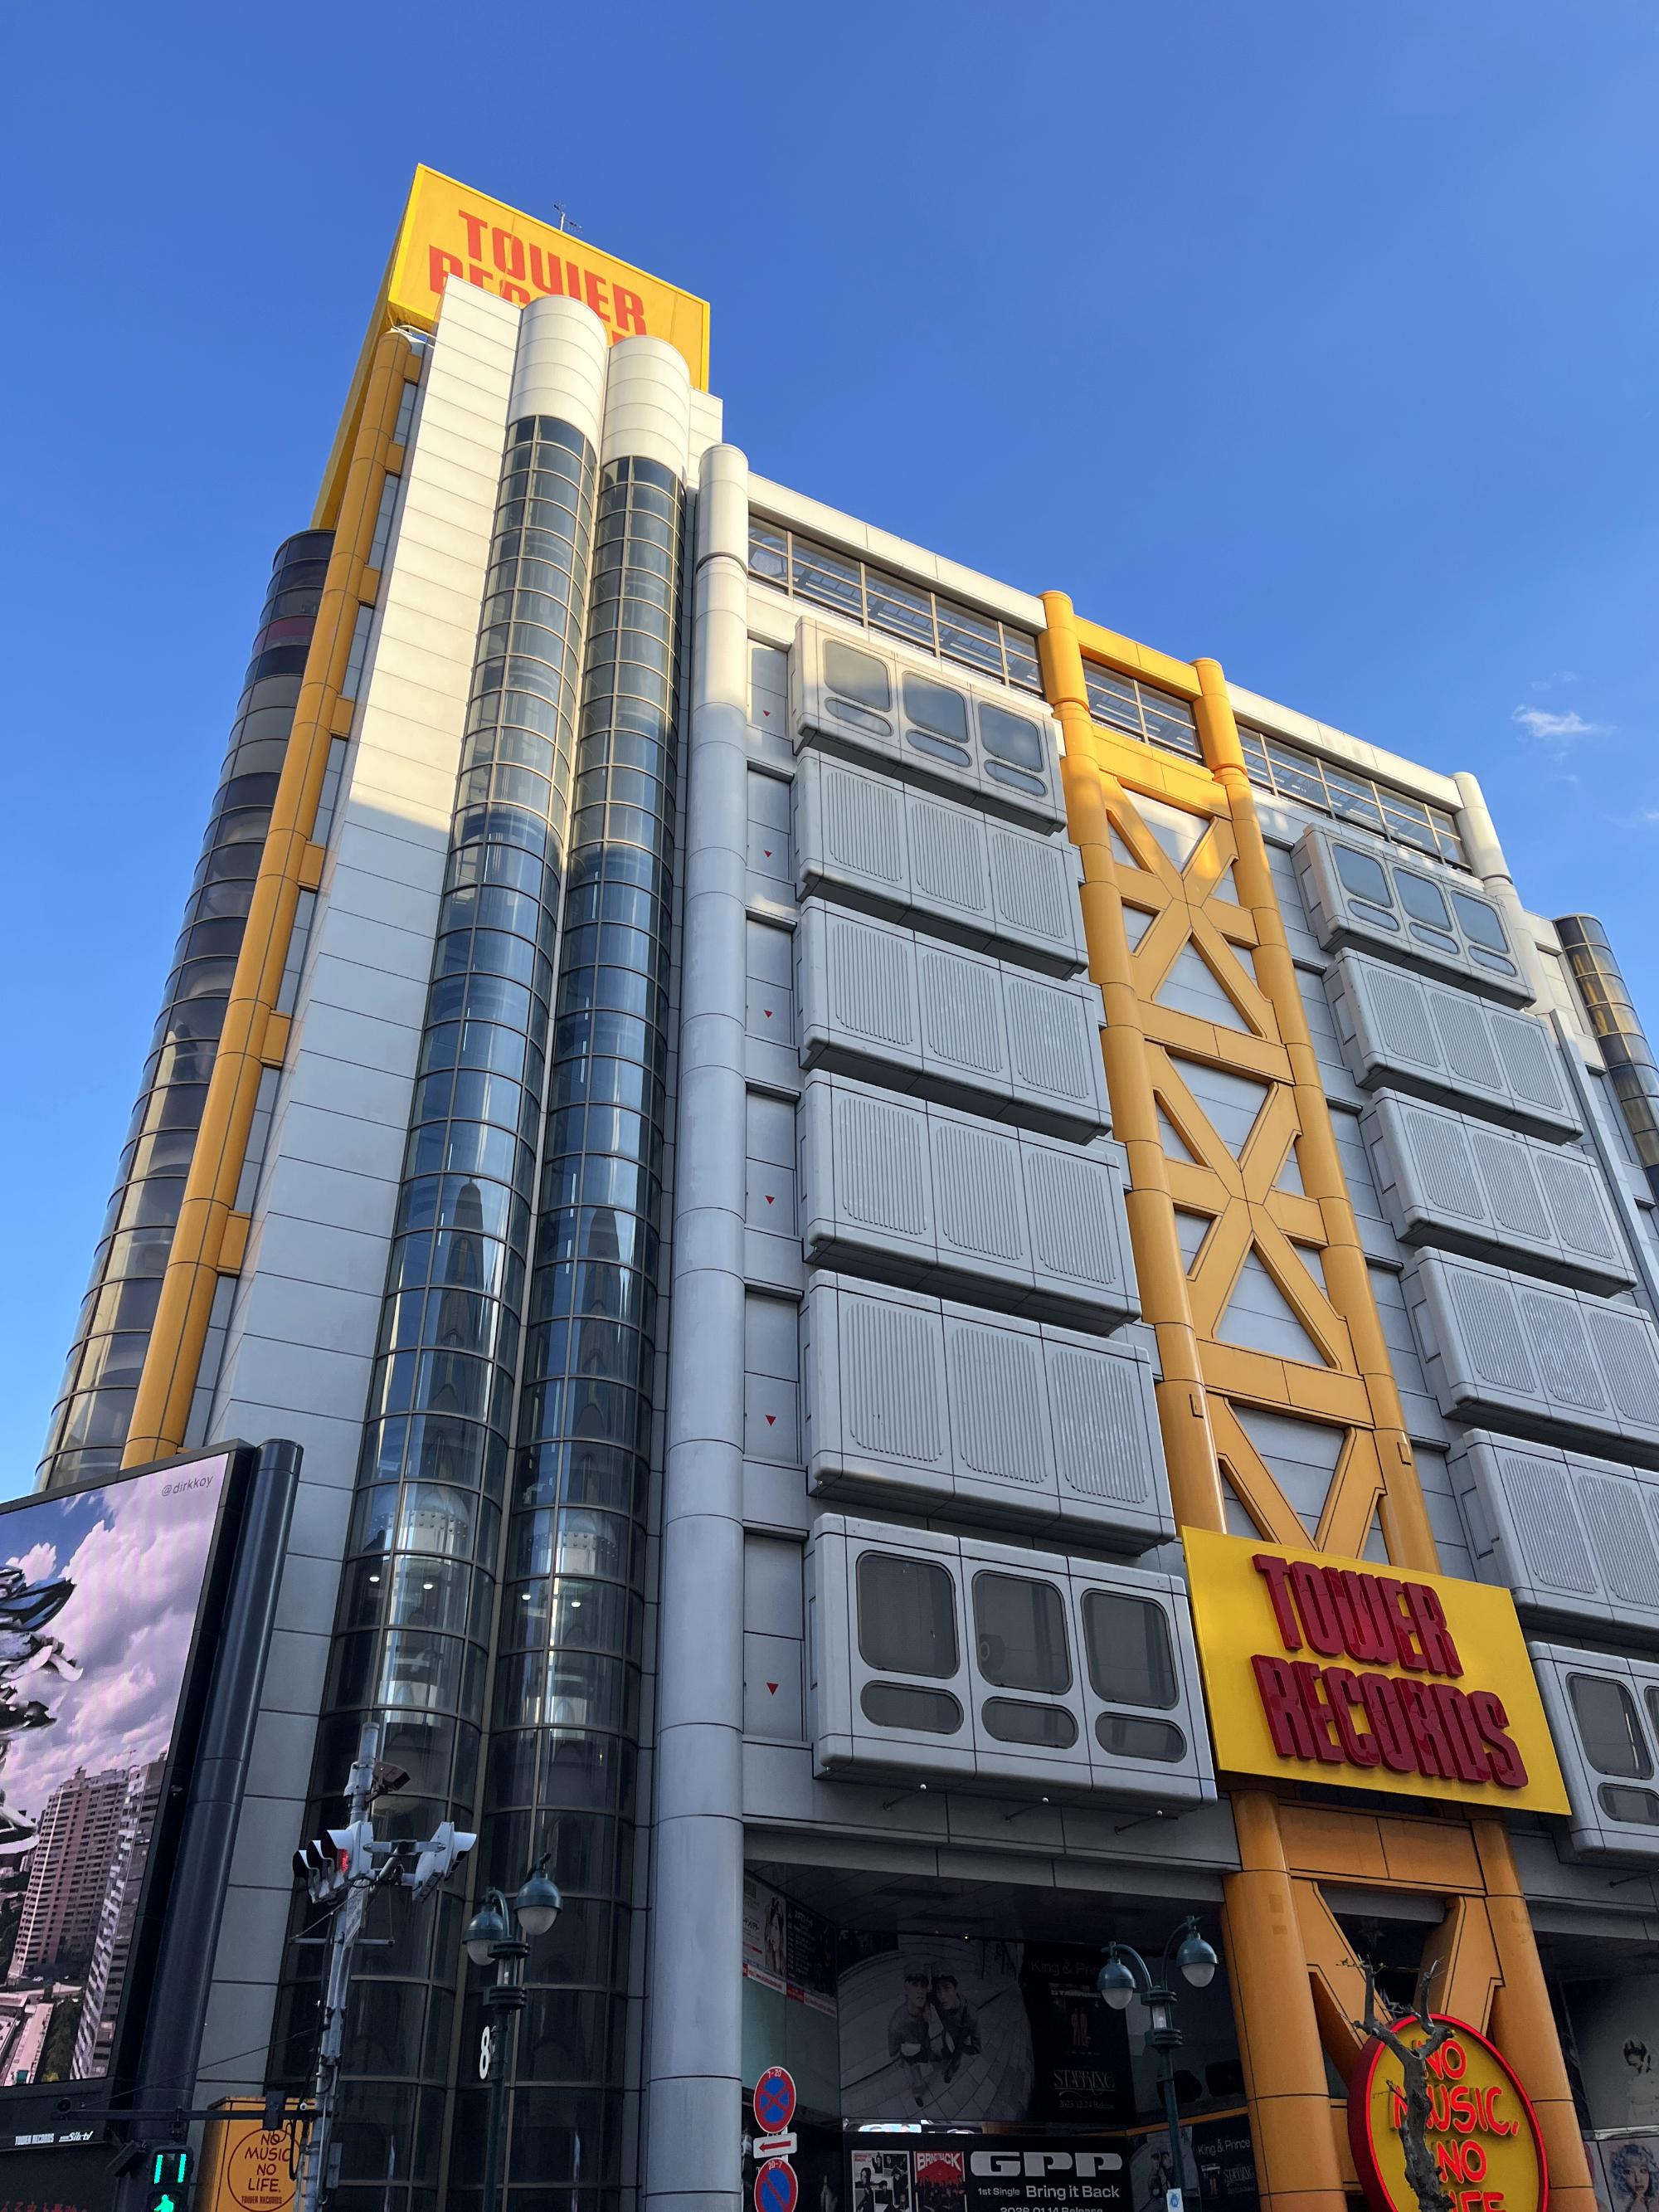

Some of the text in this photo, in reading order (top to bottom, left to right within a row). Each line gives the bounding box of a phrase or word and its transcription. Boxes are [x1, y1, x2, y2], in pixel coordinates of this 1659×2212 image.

[459, 209, 646, 335] TOWER
[161, 1476, 213, 1497] @dirkkoy
[1252, 1554, 1464, 1678] TOWER
[1250, 1654, 1529, 1789] RECORDS
[479, 2025, 490, 2080] 8
[261, 2132, 280, 2146] NO
[257, 2163, 276, 2175] NO
[971, 2151, 1122, 2177] GPP
[1437, 2139, 1486, 2184] NO
[248, 2177, 281, 2192] LIFE.
[977, 2185, 1121, 2200] 1st Single Bring it Back
